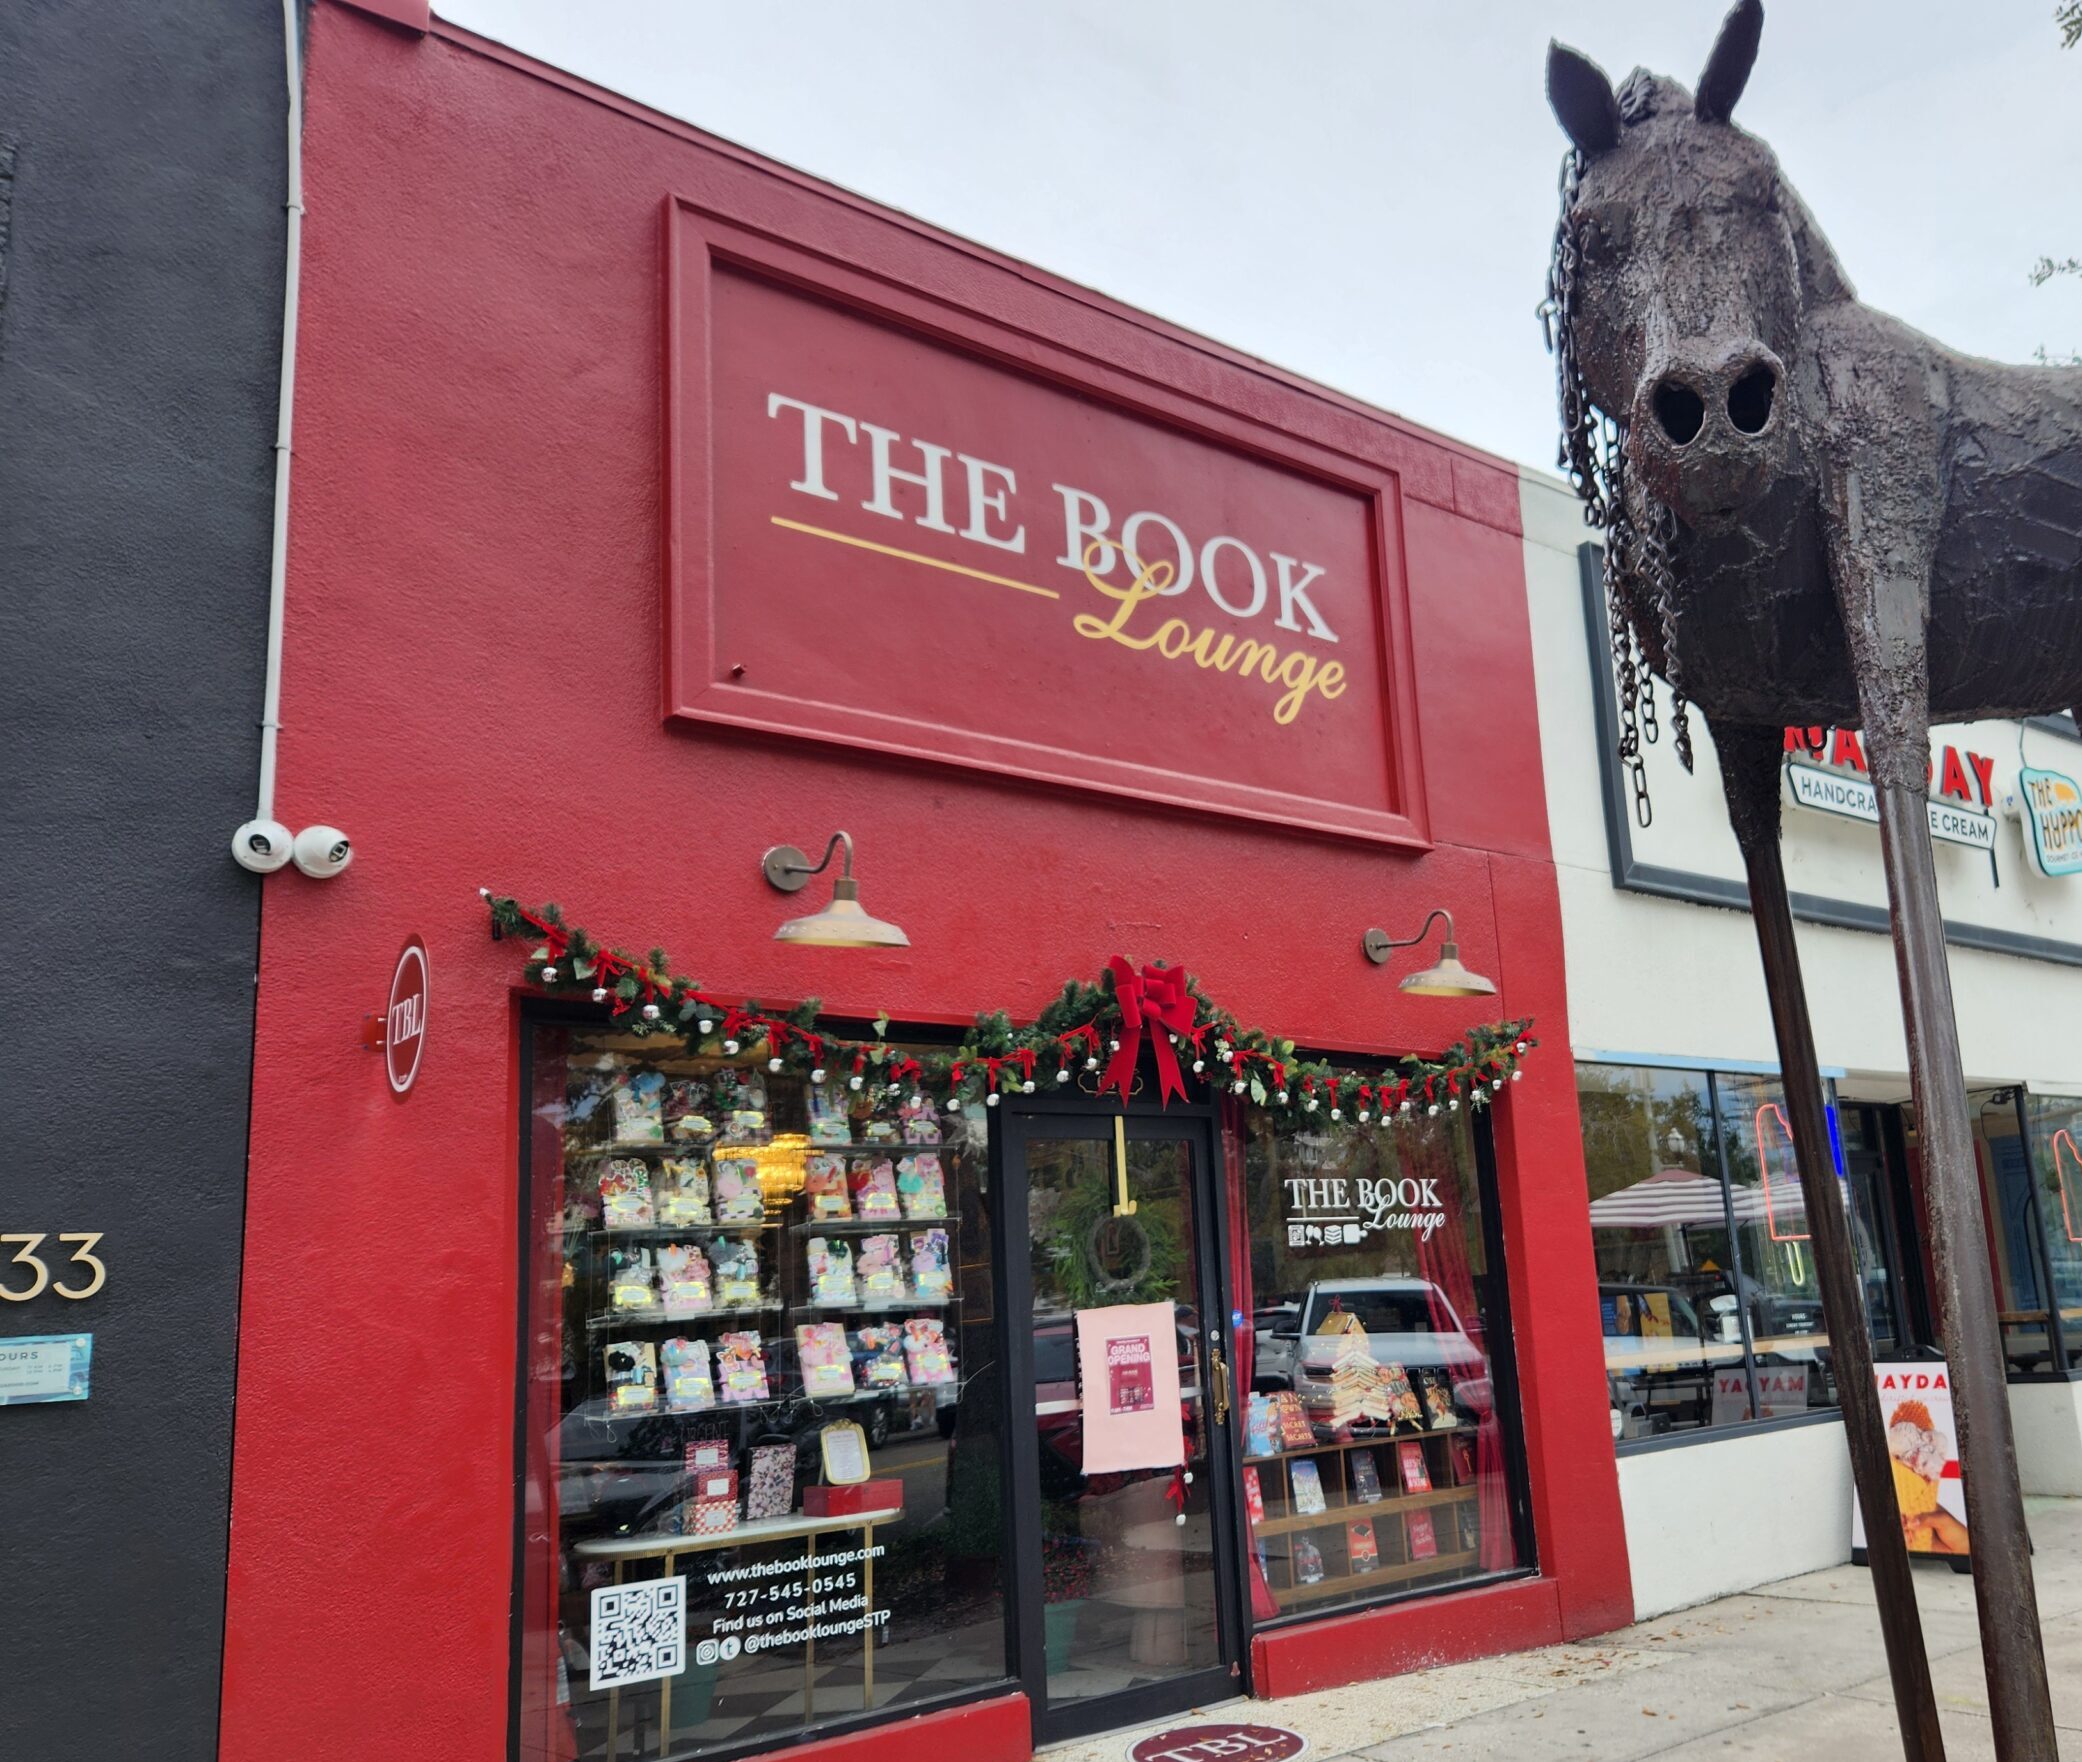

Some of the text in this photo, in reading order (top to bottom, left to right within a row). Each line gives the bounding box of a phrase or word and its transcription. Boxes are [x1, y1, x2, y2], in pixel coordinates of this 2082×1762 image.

[767, 392, 1340, 643] THE BOOK
[1073, 540, 1347, 725] Lounge
[1801, 776, 1878, 814] HANDCRA
[1942, 813, 1989, 842] CREAM
[2028, 778, 2053, 808] THE
[391, 993, 422, 1046] TBL
[1284, 1178, 1443, 1209] THE BOOK
[1363, 1194, 1446, 1242] Lounge
[0, 1233, 106, 1301] 33
[1107, 1351, 1150, 1366] OPENING
[1111, 1343, 1145, 1356] GRAND
[1875, 1374, 1948, 1390] AYDA
[706, 1544, 885, 1586] www.thebooklounge.com
[724, 1572, 857, 1609] 727-545-0545
[712, 1593, 869, 1635] Find us on Social Media
[744, 1609, 891, 1655] @thebookloungeSTP
[1144, 1731, 1289, 1762] TBL
